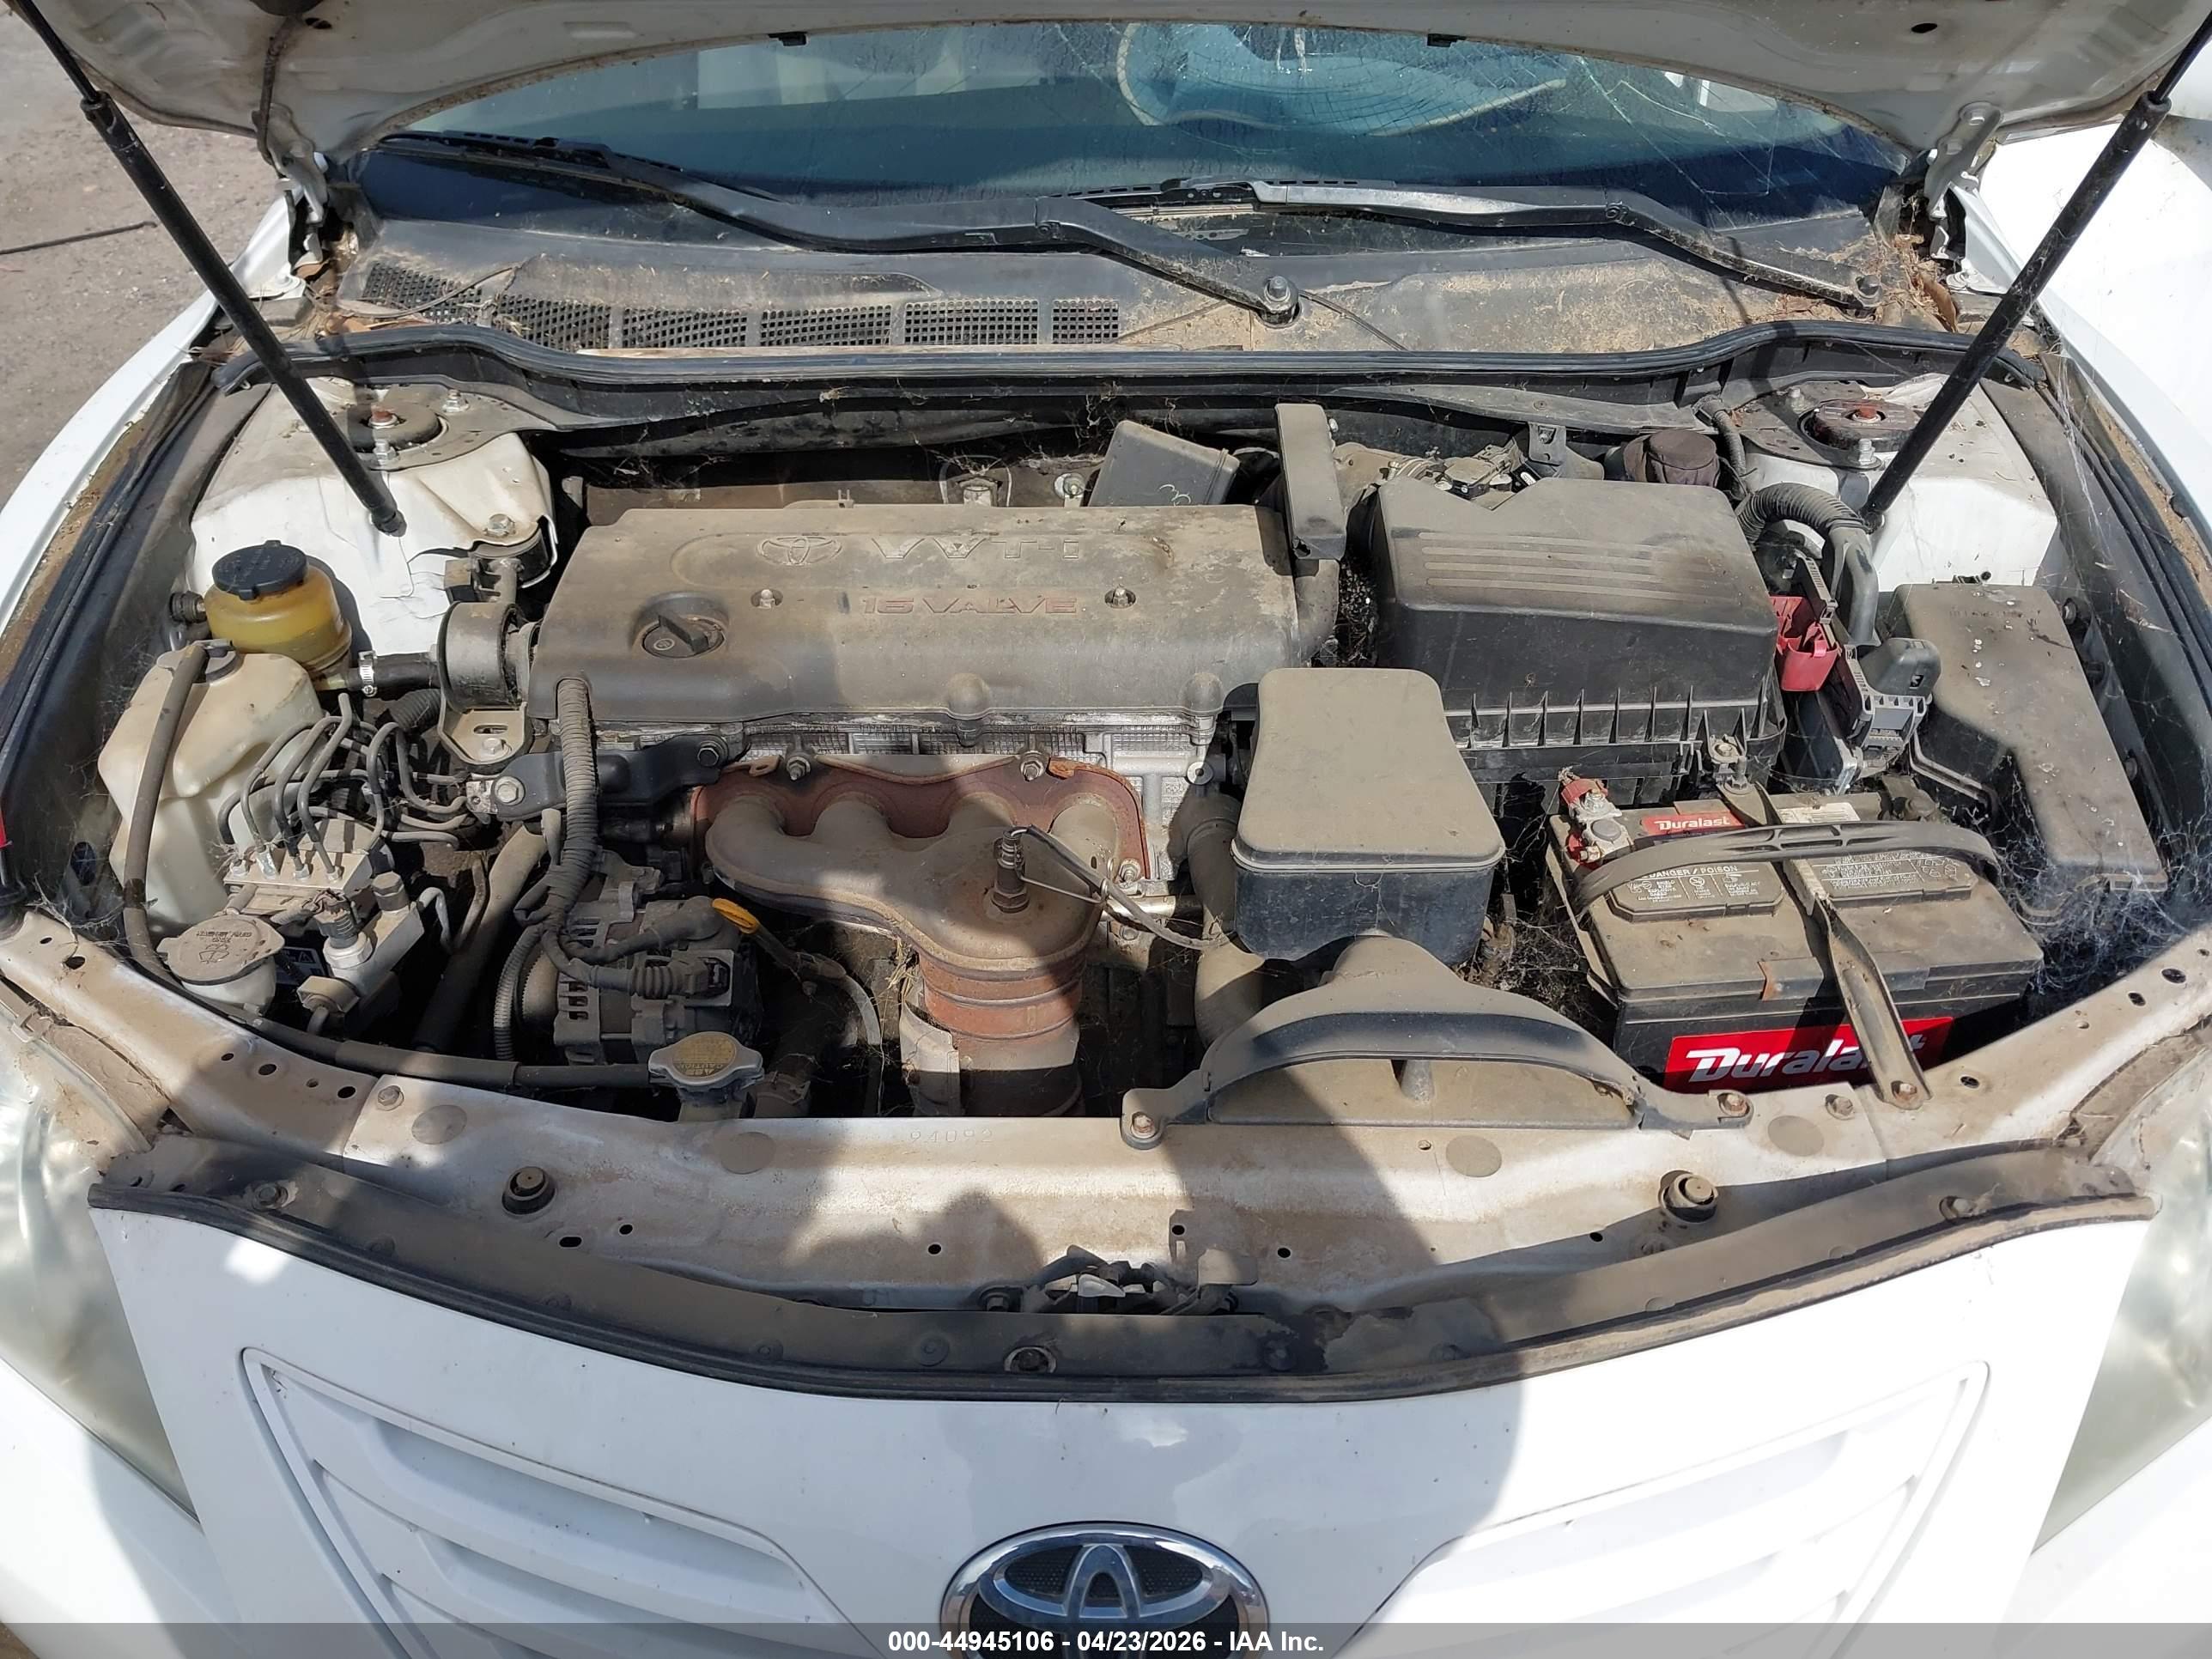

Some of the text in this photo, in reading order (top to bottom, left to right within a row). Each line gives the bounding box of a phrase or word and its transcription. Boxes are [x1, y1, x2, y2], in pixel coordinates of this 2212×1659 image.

[864, 597, 1078, 614] 16 VALVE
[1654, 816, 1730, 830] Duralast
[1699, 865, 1738, 874] POISON
